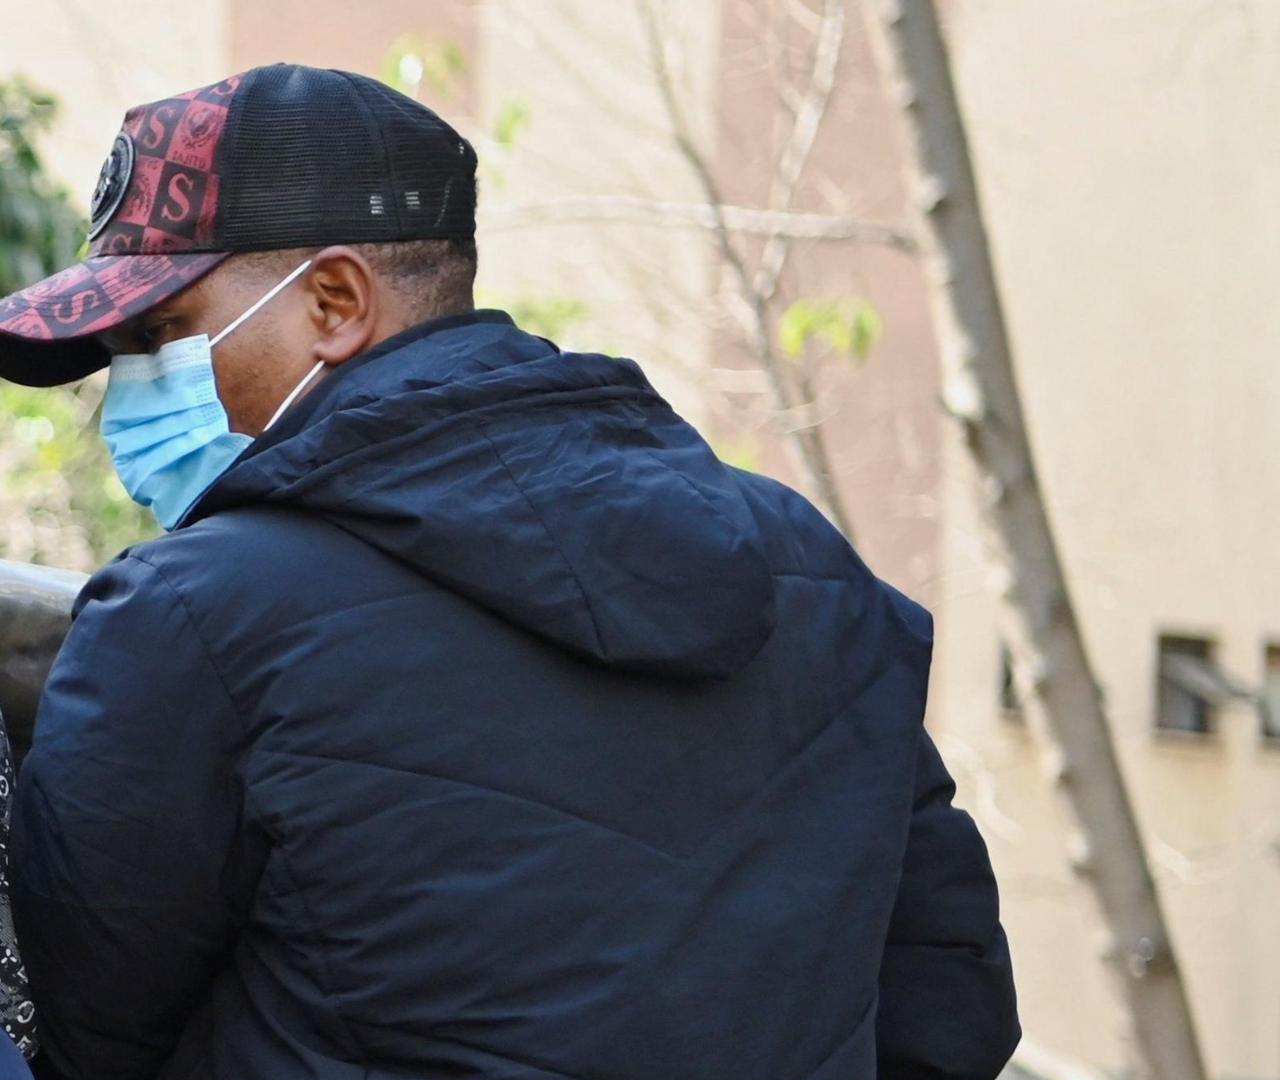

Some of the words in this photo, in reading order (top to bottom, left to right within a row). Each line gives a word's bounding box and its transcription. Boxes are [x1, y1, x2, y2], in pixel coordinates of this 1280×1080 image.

[144, 106, 176, 149] S
[162, 172, 194, 222] S
[52, 289, 100, 324] S
